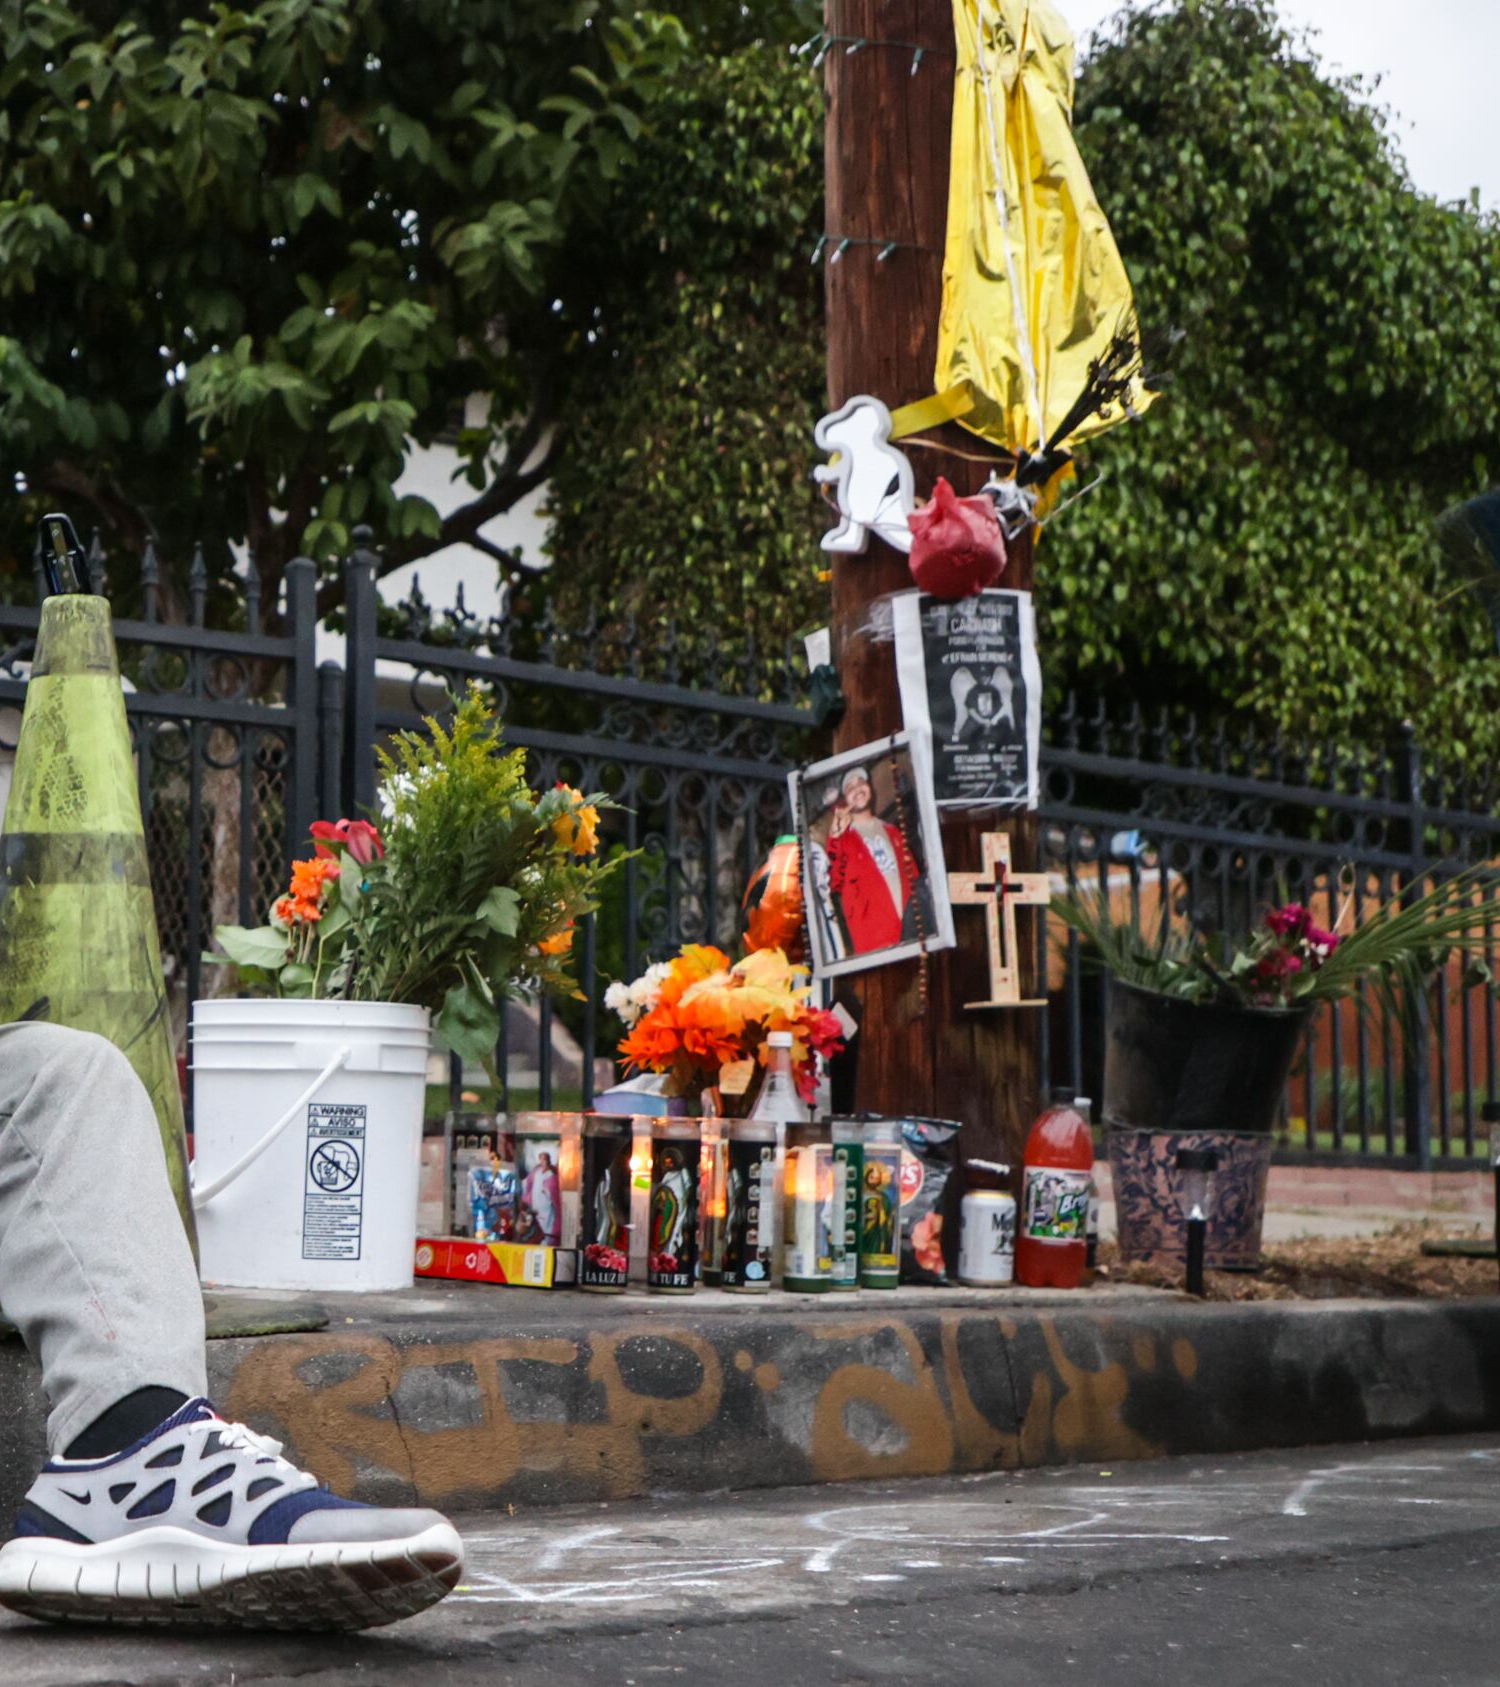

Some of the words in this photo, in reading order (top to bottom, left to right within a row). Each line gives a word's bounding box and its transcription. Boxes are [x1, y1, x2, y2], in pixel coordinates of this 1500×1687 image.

[320, 1106, 364, 1116] WARNING
[328, 1118, 356, 1127] AVISO
[585, 1271, 597, 1283] LA
[598, 1271, 616, 1284] LUZ
[673, 1273, 689, 1286] FE
